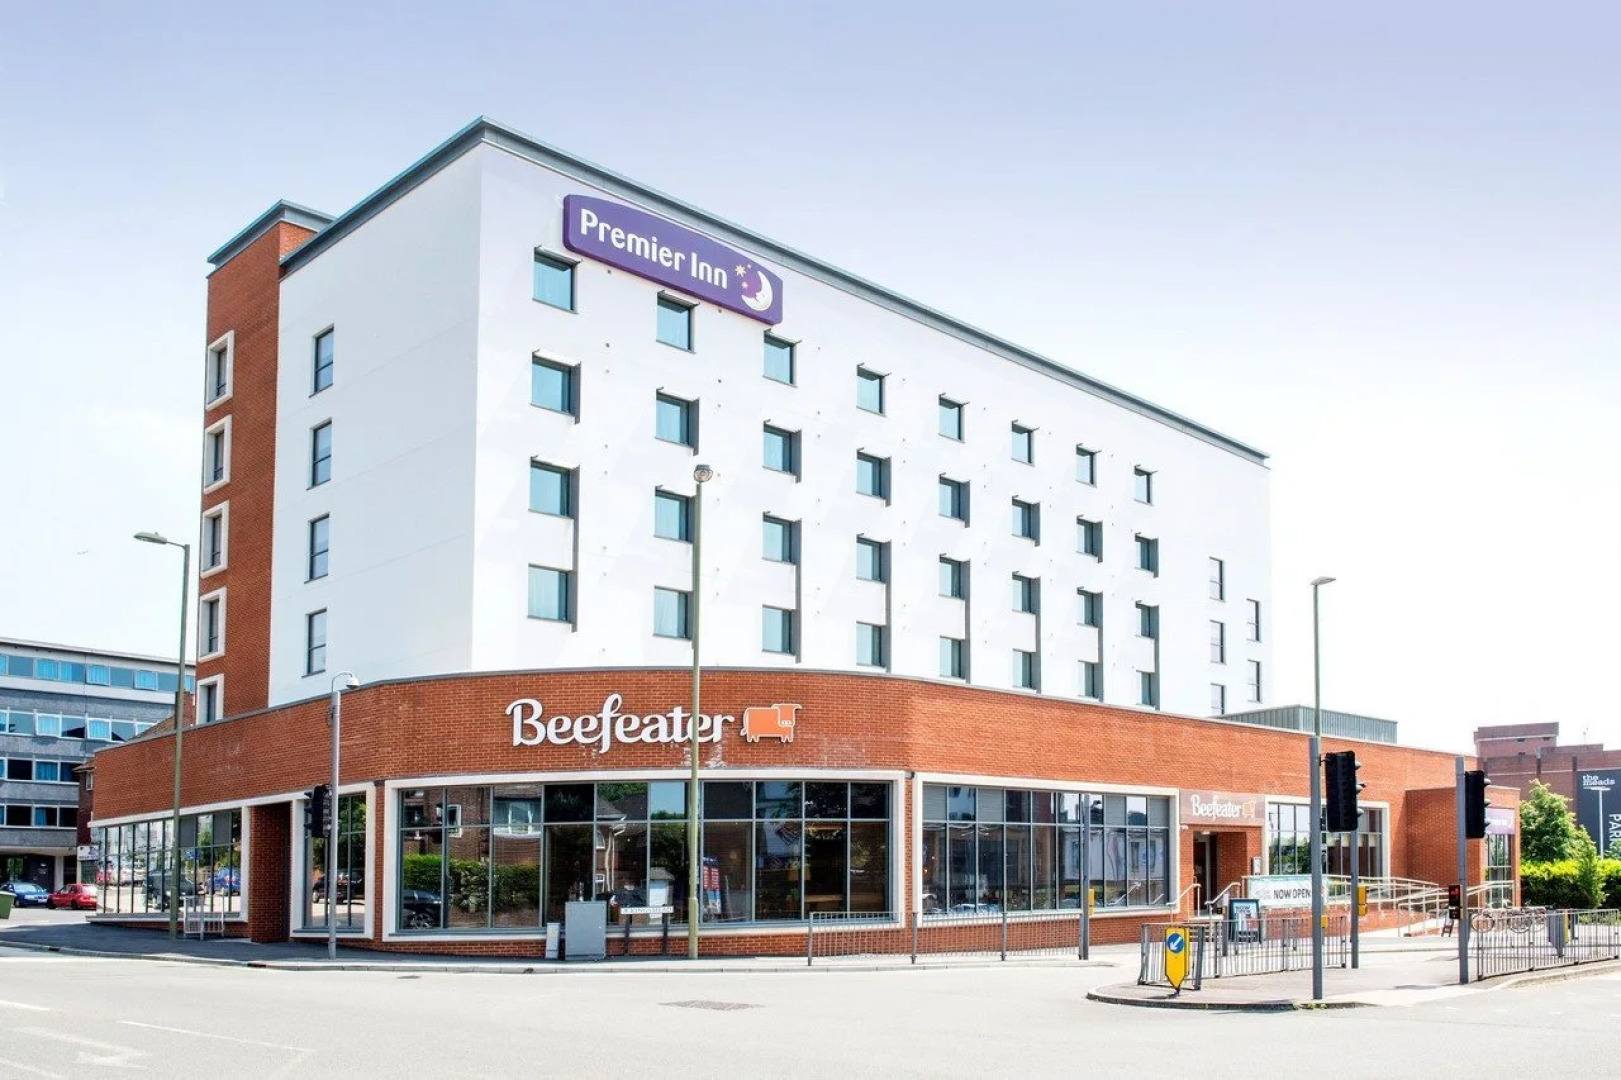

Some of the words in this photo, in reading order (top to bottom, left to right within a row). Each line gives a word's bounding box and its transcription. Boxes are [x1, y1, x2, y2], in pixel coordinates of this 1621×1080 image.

[580, 208, 686, 271] Premier
[691, 252, 727, 289] Inn
[505, 693, 735, 754] Beefeater
[1190, 794, 1241, 821] Beefeater
[1273, 889, 1291, 899] NOW
[1293, 888, 1311, 899] OPEN
